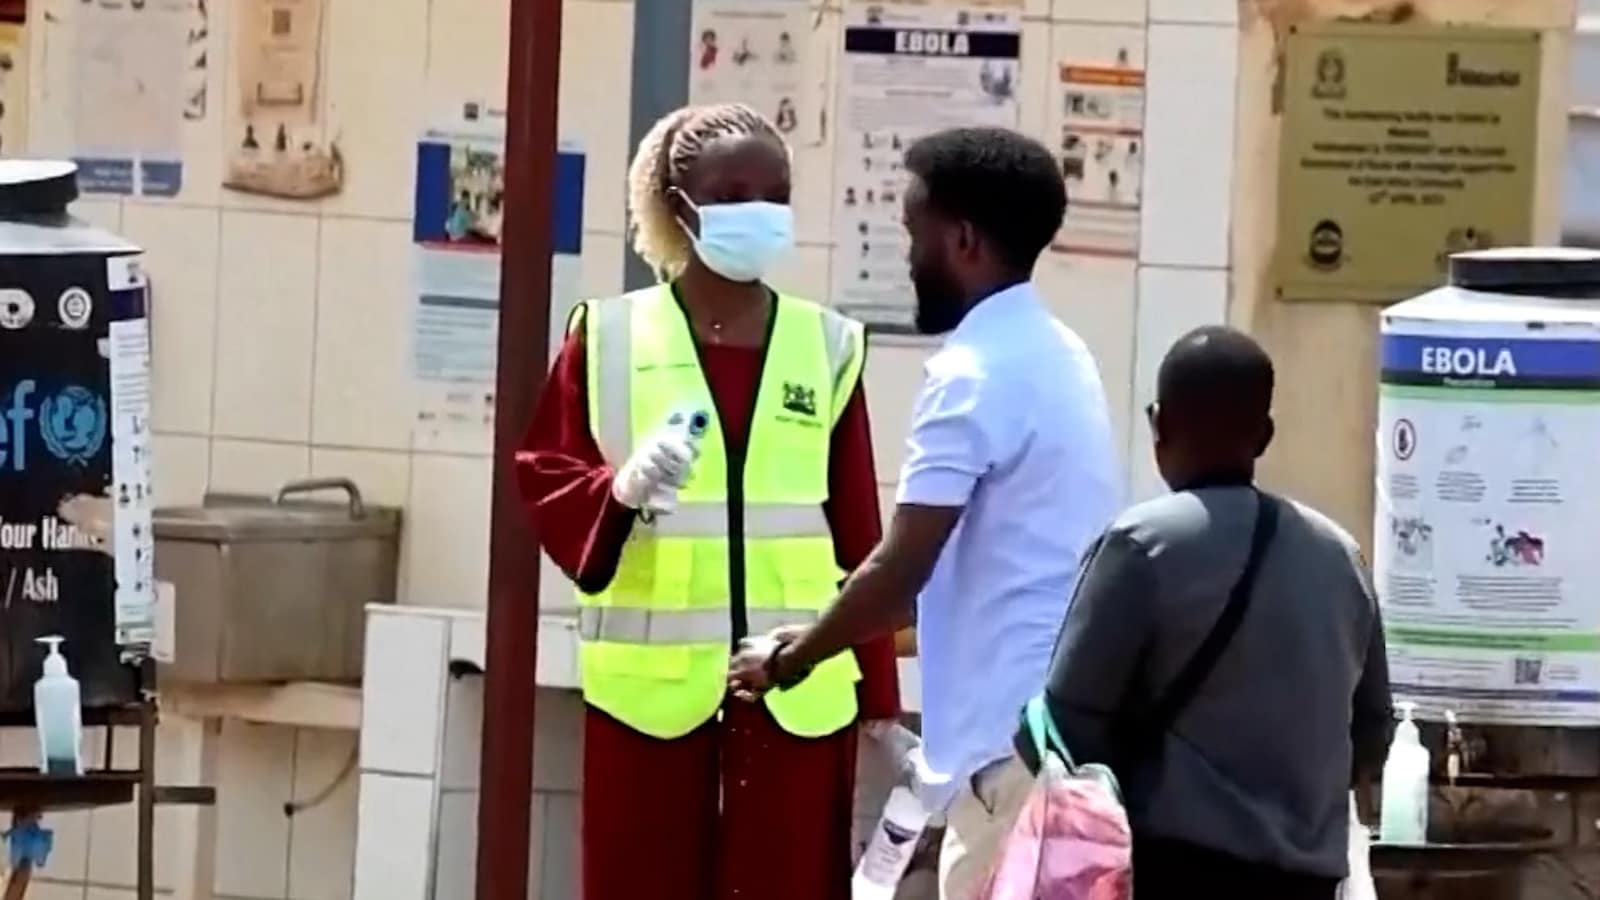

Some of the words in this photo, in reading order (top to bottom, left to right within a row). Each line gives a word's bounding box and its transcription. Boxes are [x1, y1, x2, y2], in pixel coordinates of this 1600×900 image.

[895, 31, 970, 55] EBOLA
[1421, 347, 1517, 376] EBOLA
[0, 515, 37, 549] our
[22, 567, 59, 601] Ash
